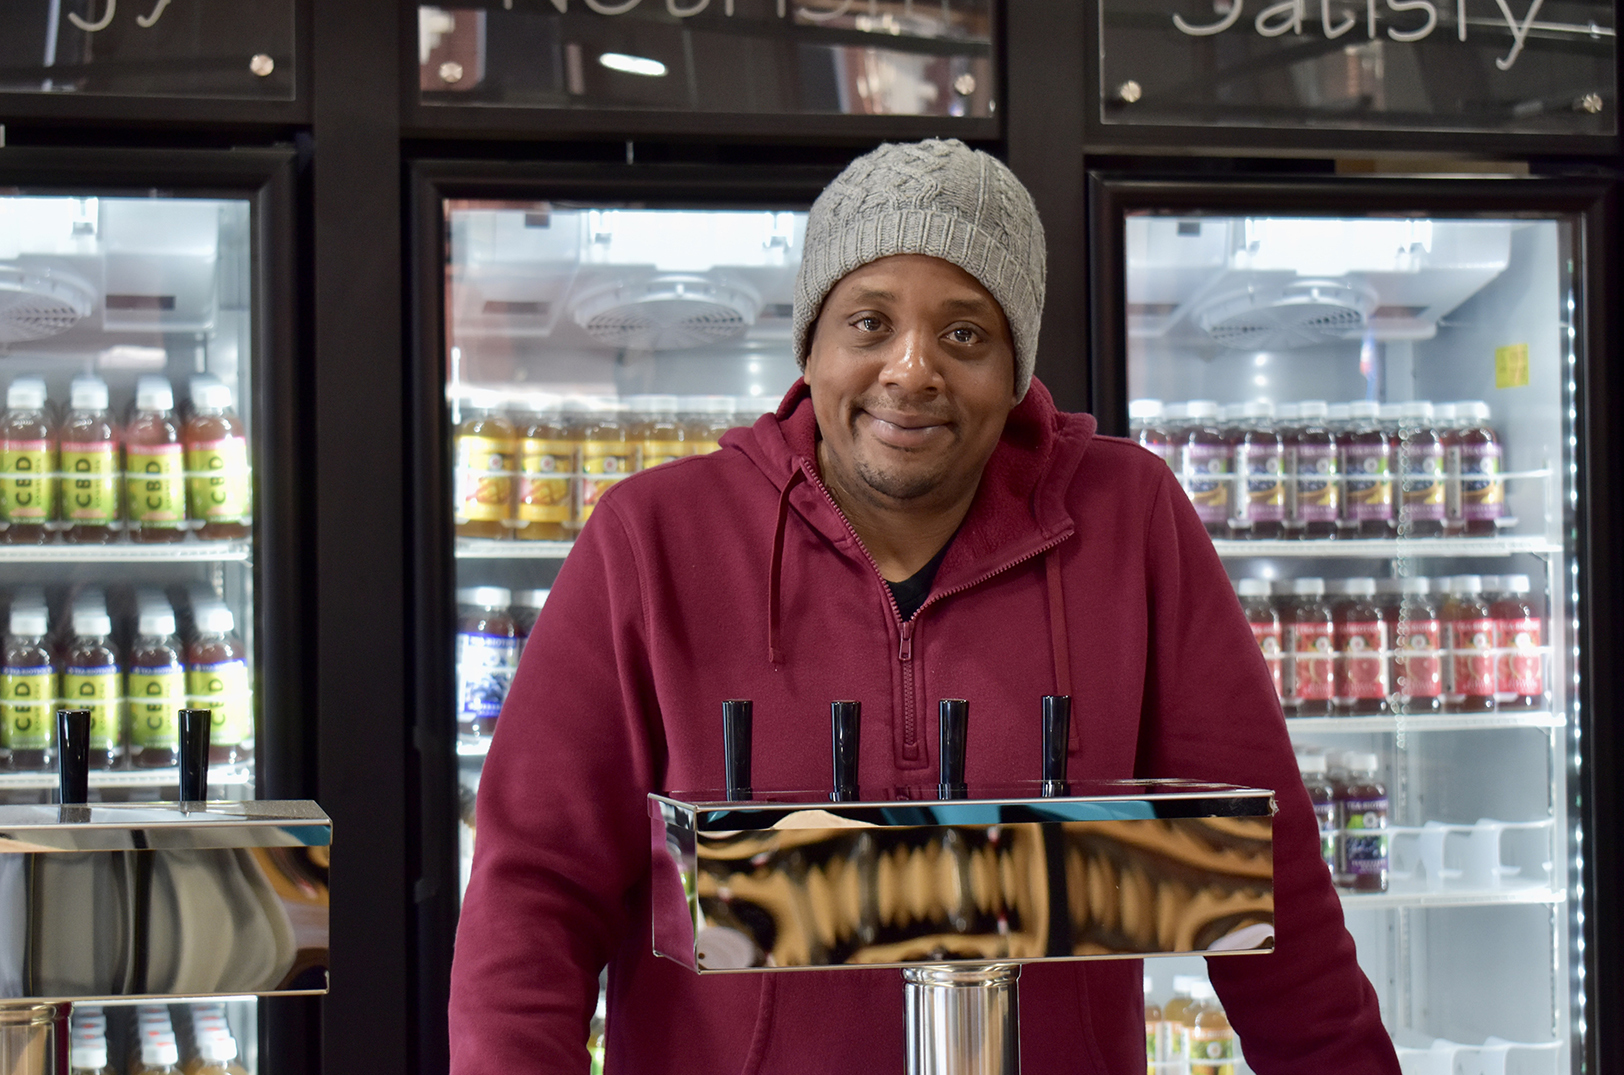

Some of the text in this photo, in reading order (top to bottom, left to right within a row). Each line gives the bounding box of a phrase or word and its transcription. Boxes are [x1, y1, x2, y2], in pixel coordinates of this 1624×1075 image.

[15, 456, 33, 507] CBD
[75, 458, 92, 509] CBD
[145, 461, 162, 511] CBD
[208, 455, 227, 505] CBD
